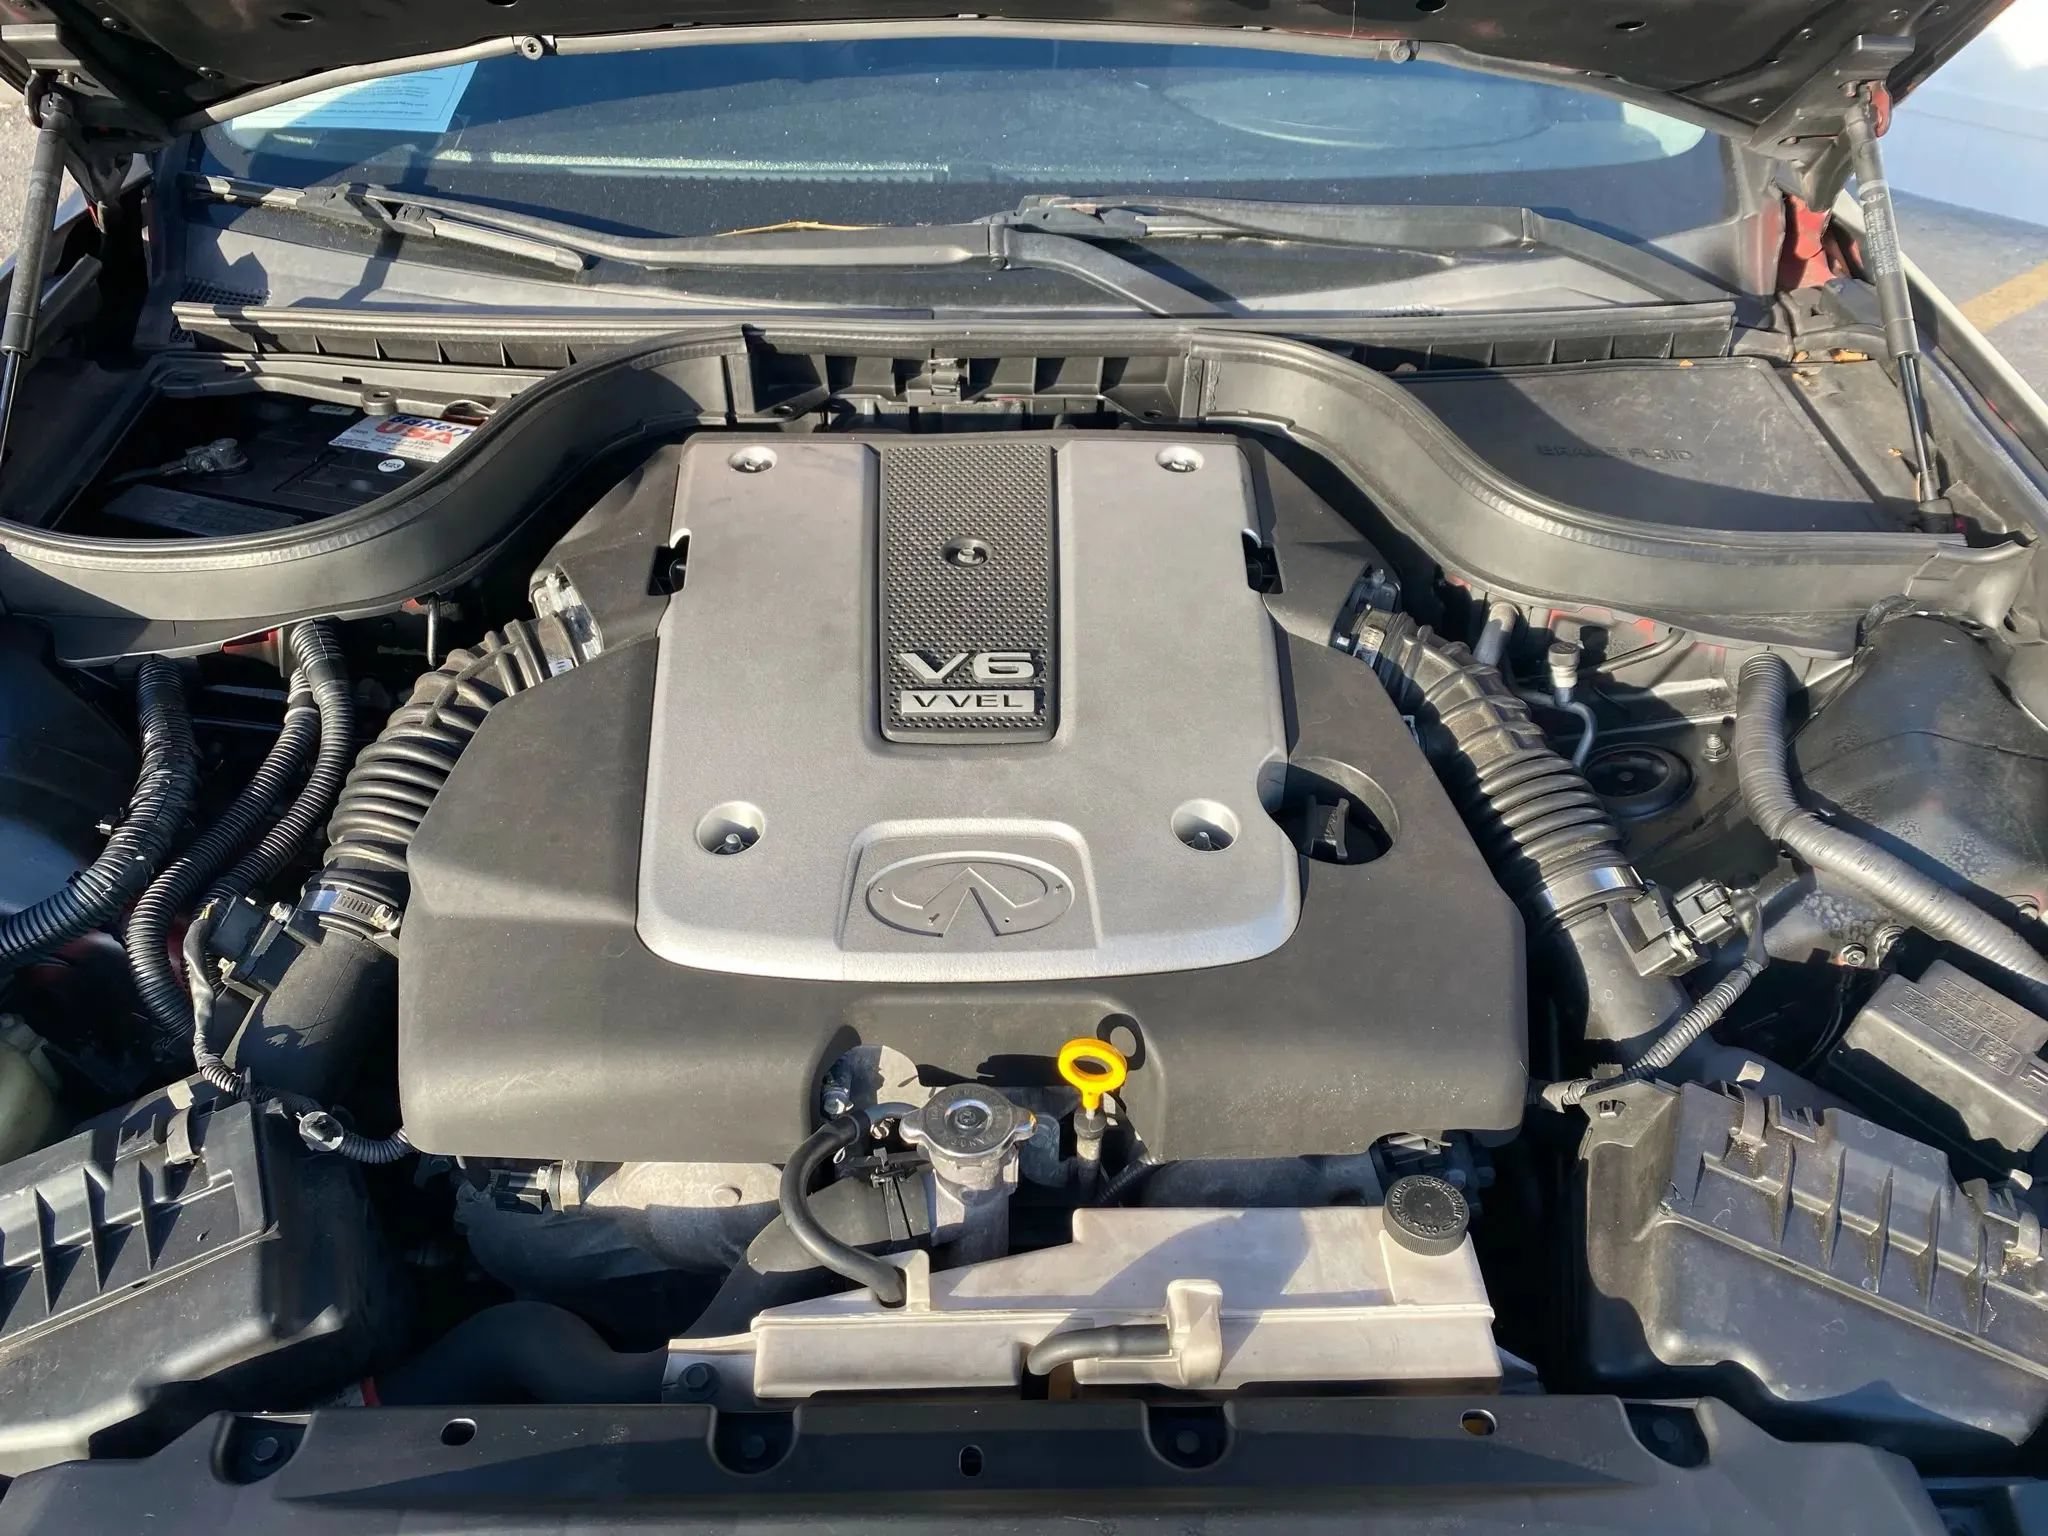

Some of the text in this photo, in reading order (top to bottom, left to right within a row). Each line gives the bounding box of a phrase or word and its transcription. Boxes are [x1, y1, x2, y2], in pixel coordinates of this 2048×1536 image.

[375, 422, 453, 445] USA
[386, 414, 472, 437] Battery
[1537, 444, 1693, 461] BRAKE FLUID
[900, 651, 1035, 684] V6
[912, 694, 1024, 708] VVEL
